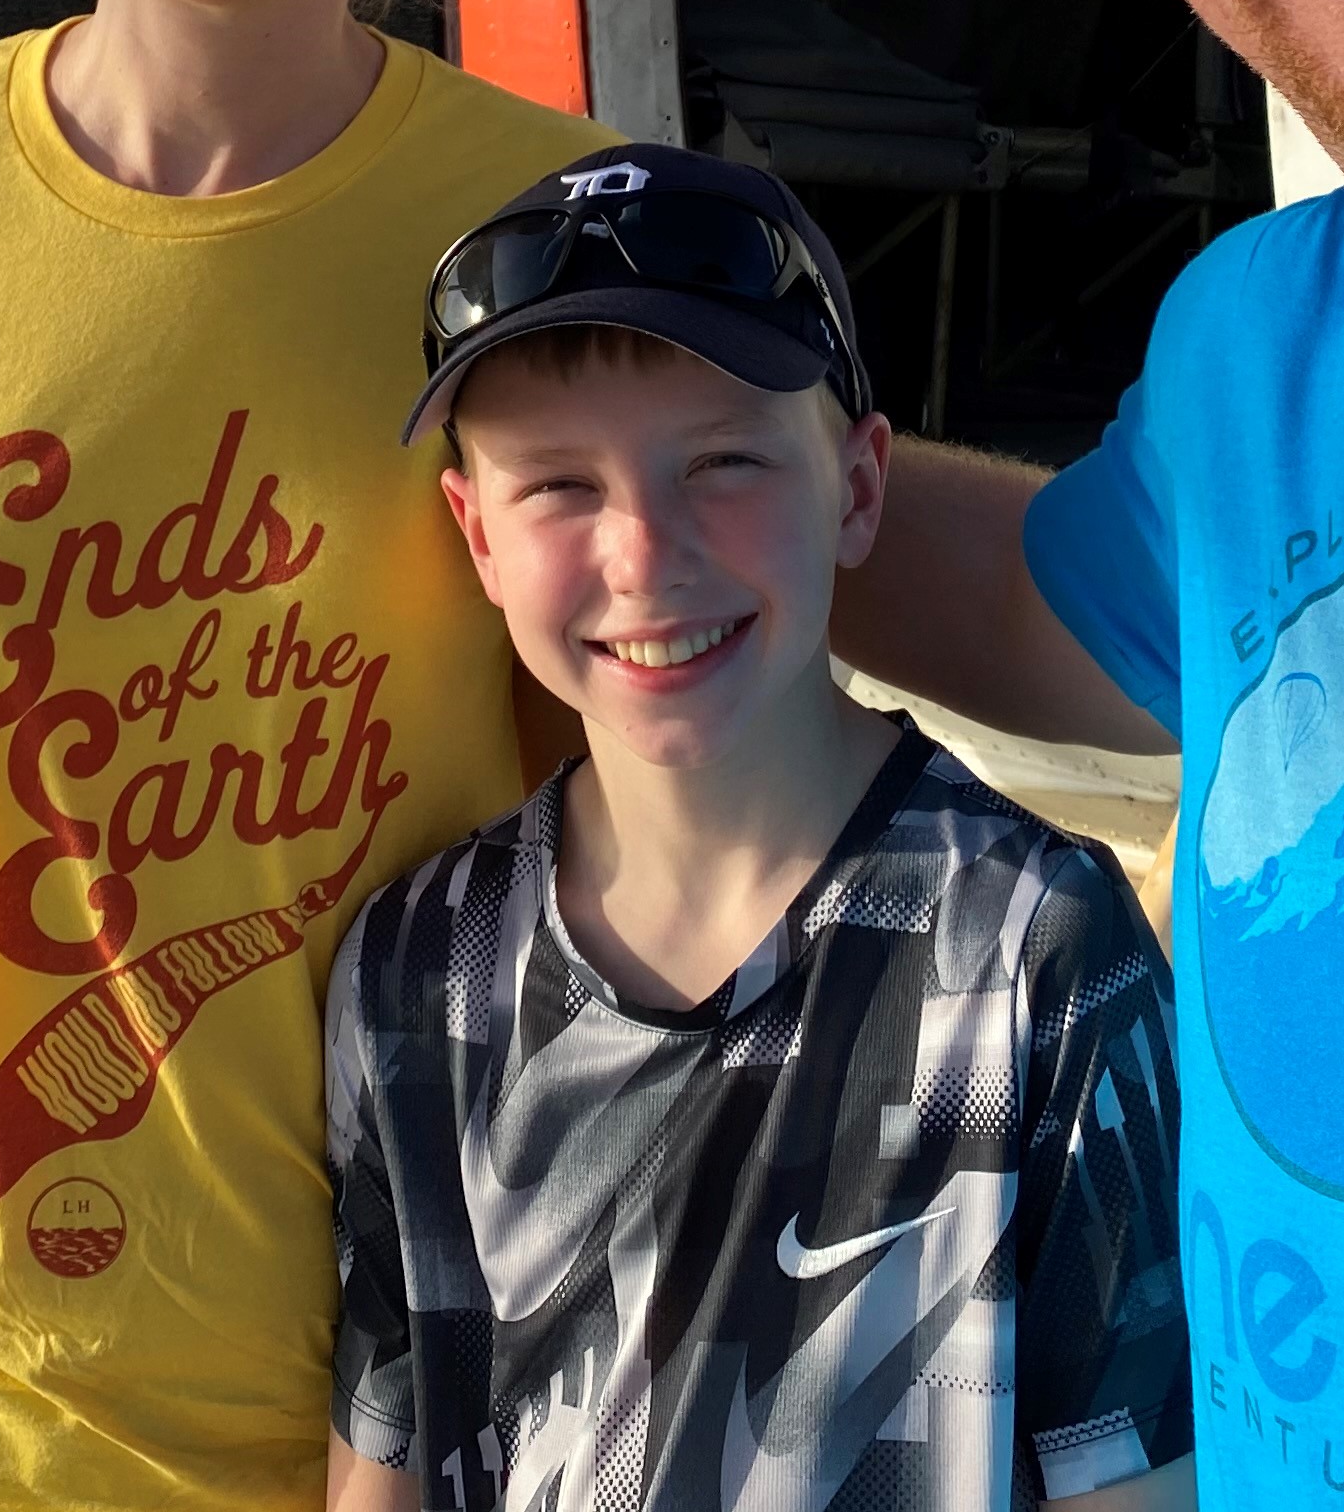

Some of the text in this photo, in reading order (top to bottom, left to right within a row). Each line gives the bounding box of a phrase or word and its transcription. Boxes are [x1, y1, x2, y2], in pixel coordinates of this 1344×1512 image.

[118, 600, 366, 743] of the
[16, 992, 150, 1136] WOULD
[156, 912, 287, 1005] FOLLOW
